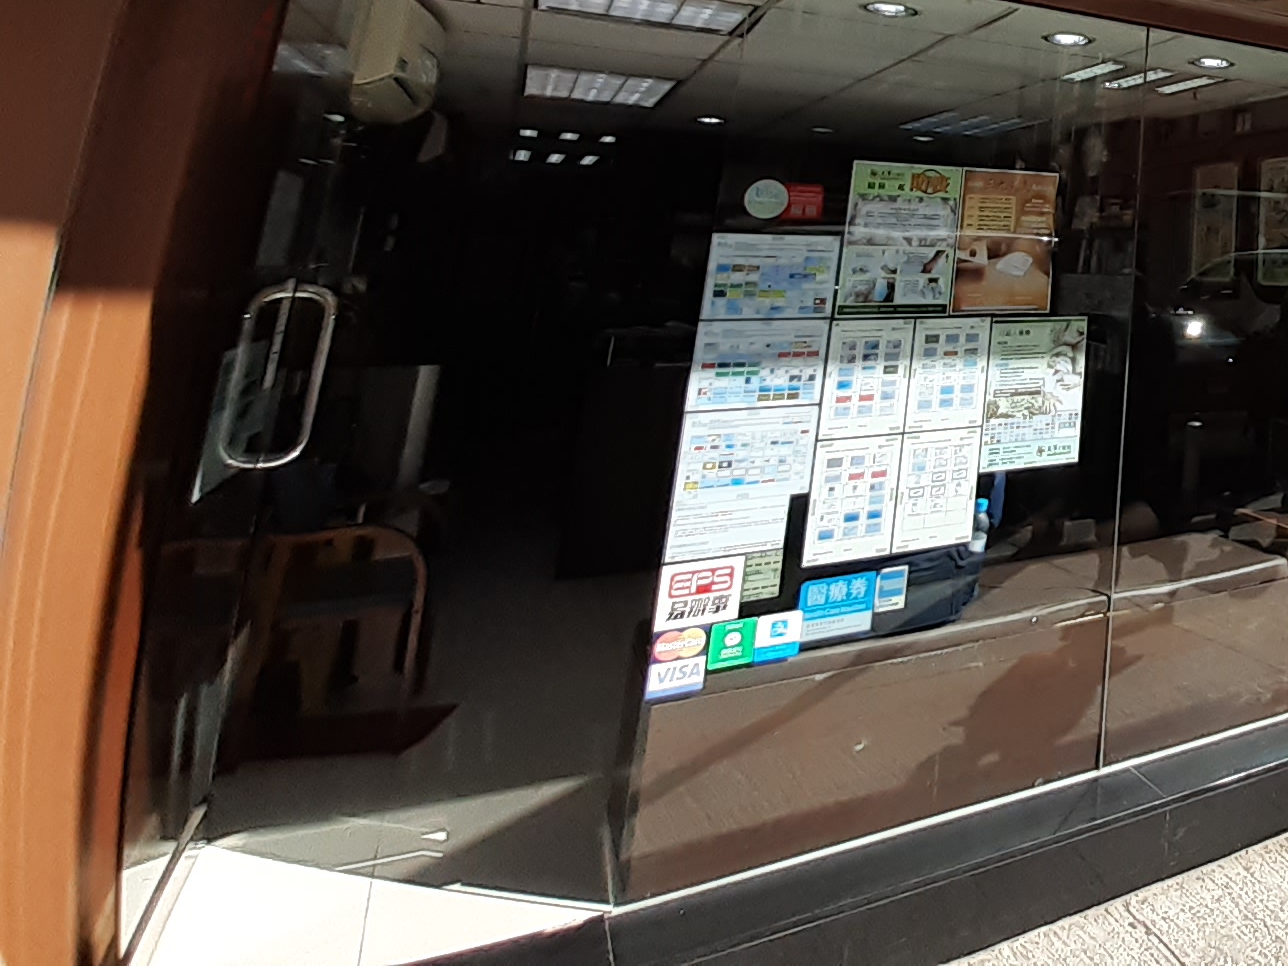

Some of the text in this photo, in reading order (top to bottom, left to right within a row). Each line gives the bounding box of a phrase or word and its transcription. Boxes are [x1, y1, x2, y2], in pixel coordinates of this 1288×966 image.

[671, 568, 732, 596] EPS
[807, 576, 870, 607] 醫療券
[658, 663, 701, 685] VISA
